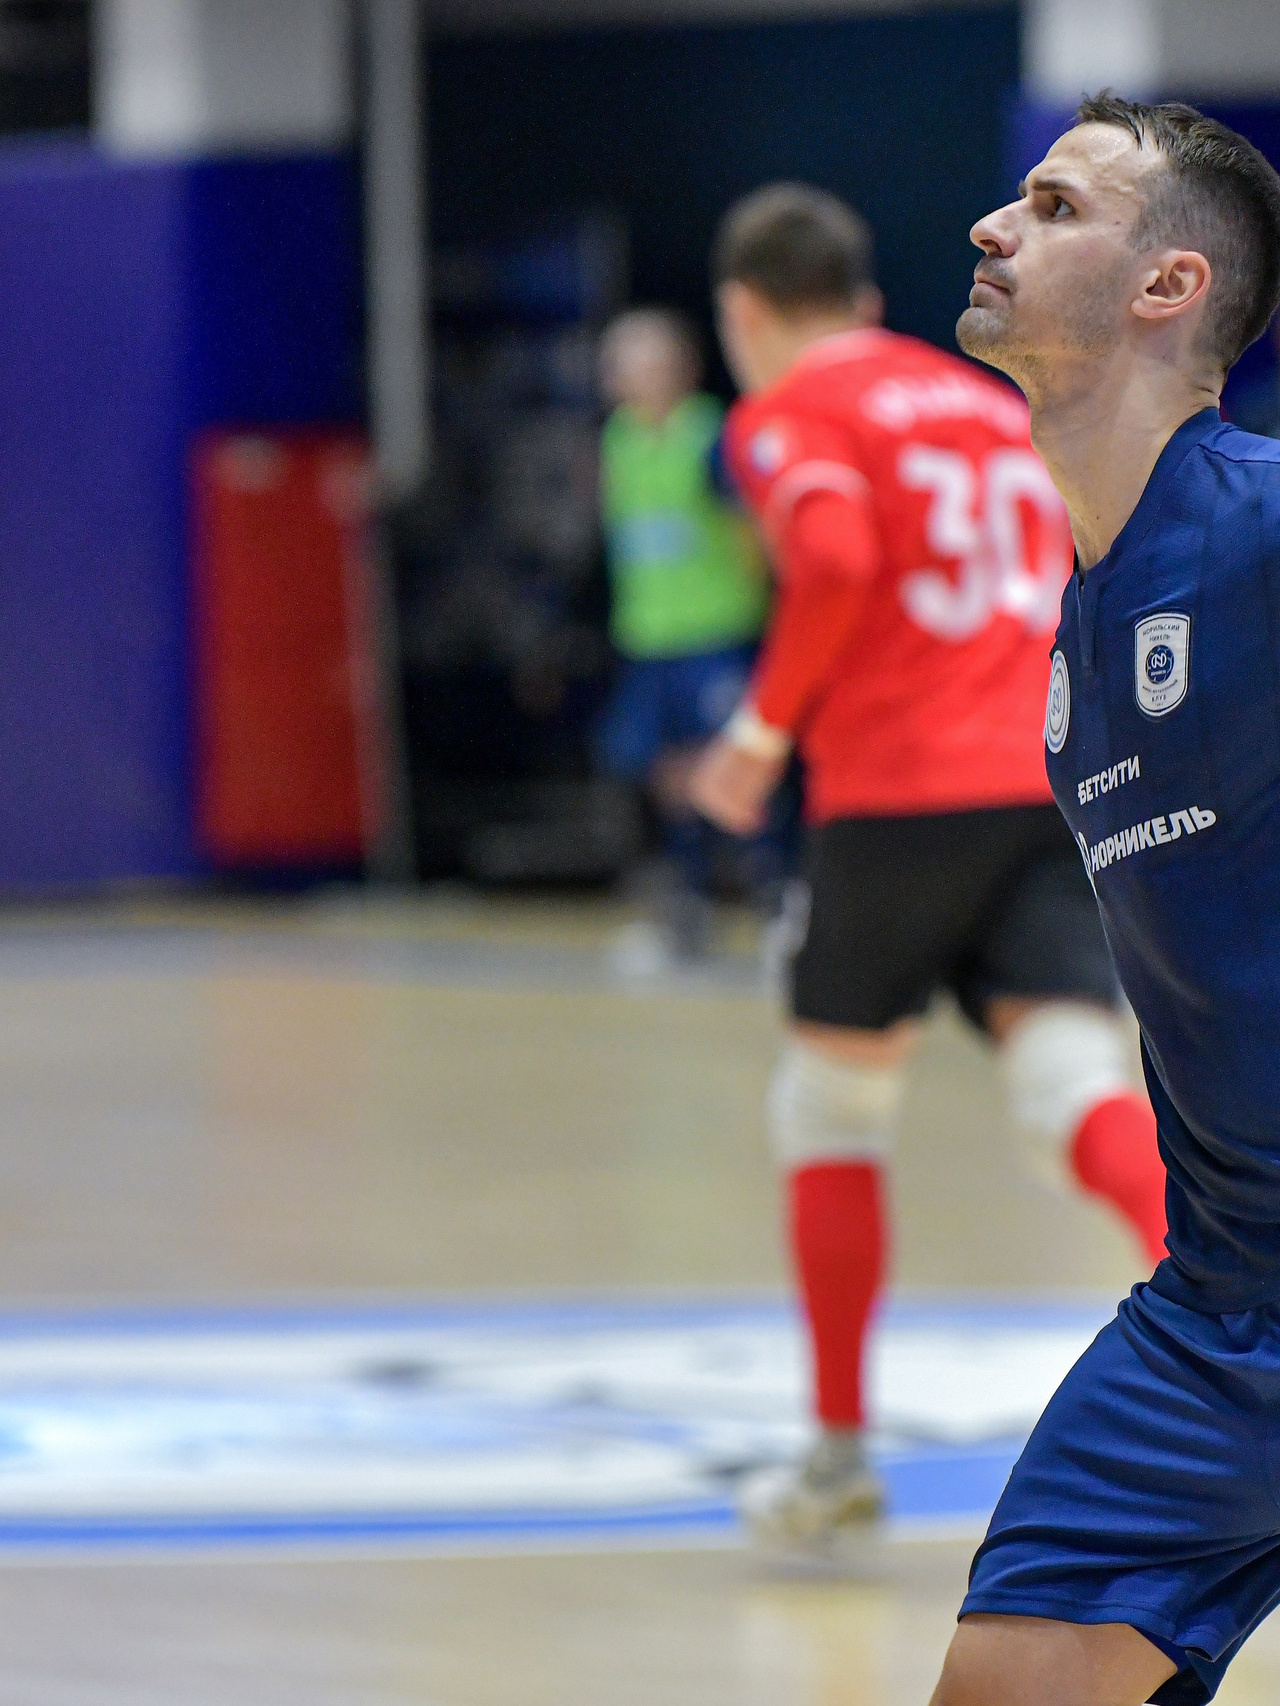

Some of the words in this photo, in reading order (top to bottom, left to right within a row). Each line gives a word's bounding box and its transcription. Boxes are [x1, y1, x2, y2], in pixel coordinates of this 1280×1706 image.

[898, 443, 1070, 642] 30
[1077, 755, 1140, 806] БЕТСИТИ
[1090, 805, 1217, 873] НОРНИКЕЛЬ
